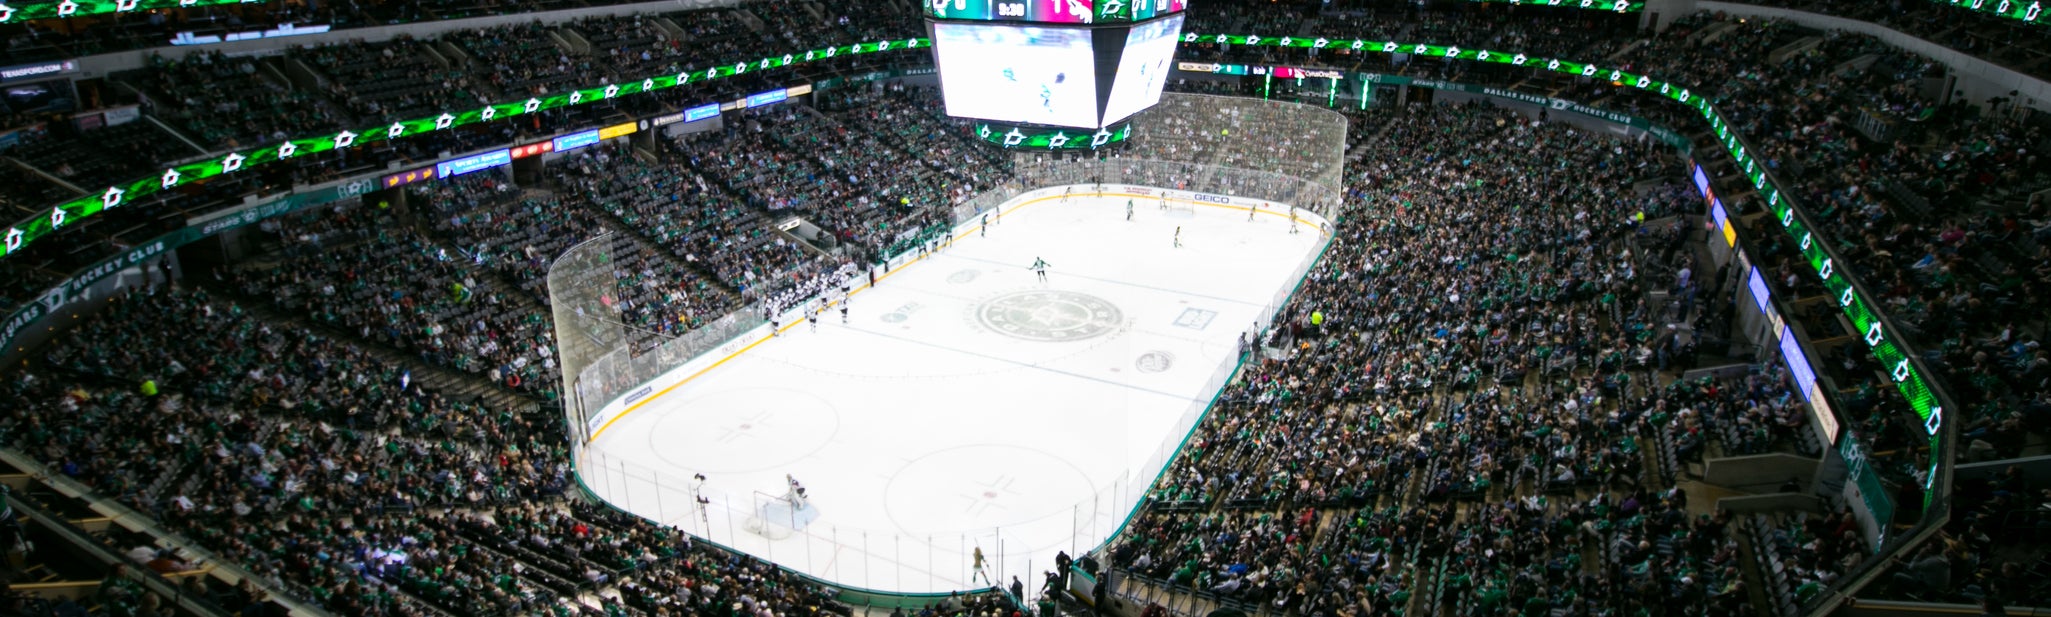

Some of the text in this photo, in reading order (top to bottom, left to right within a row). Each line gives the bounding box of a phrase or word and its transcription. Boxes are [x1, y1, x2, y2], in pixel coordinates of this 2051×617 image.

[1483, 88, 1632, 124] DALLAS STARS HOCKEY CLUB
[1194, 193, 1230, 204] GEICO
[73, 257, 123, 291] HOCKEY
[128, 241, 165, 263] CLUB
